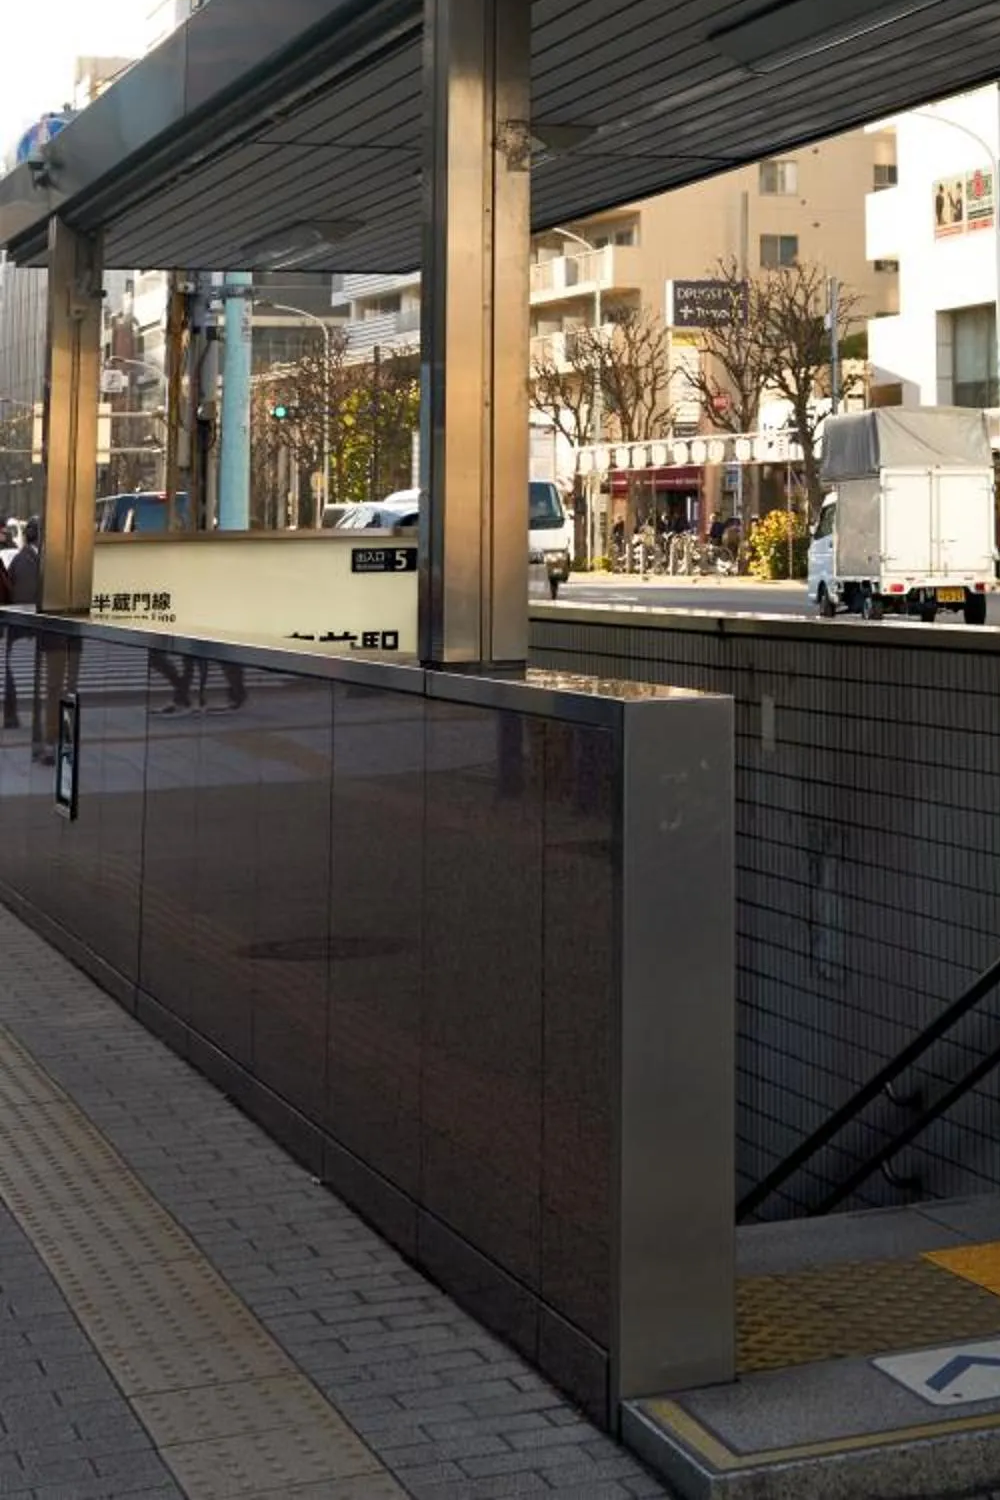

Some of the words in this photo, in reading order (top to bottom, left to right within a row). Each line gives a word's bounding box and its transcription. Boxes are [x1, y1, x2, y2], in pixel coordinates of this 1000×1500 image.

[394, 549, 408, 569] 5
[92, 592, 171, 612] 半蔵門線
